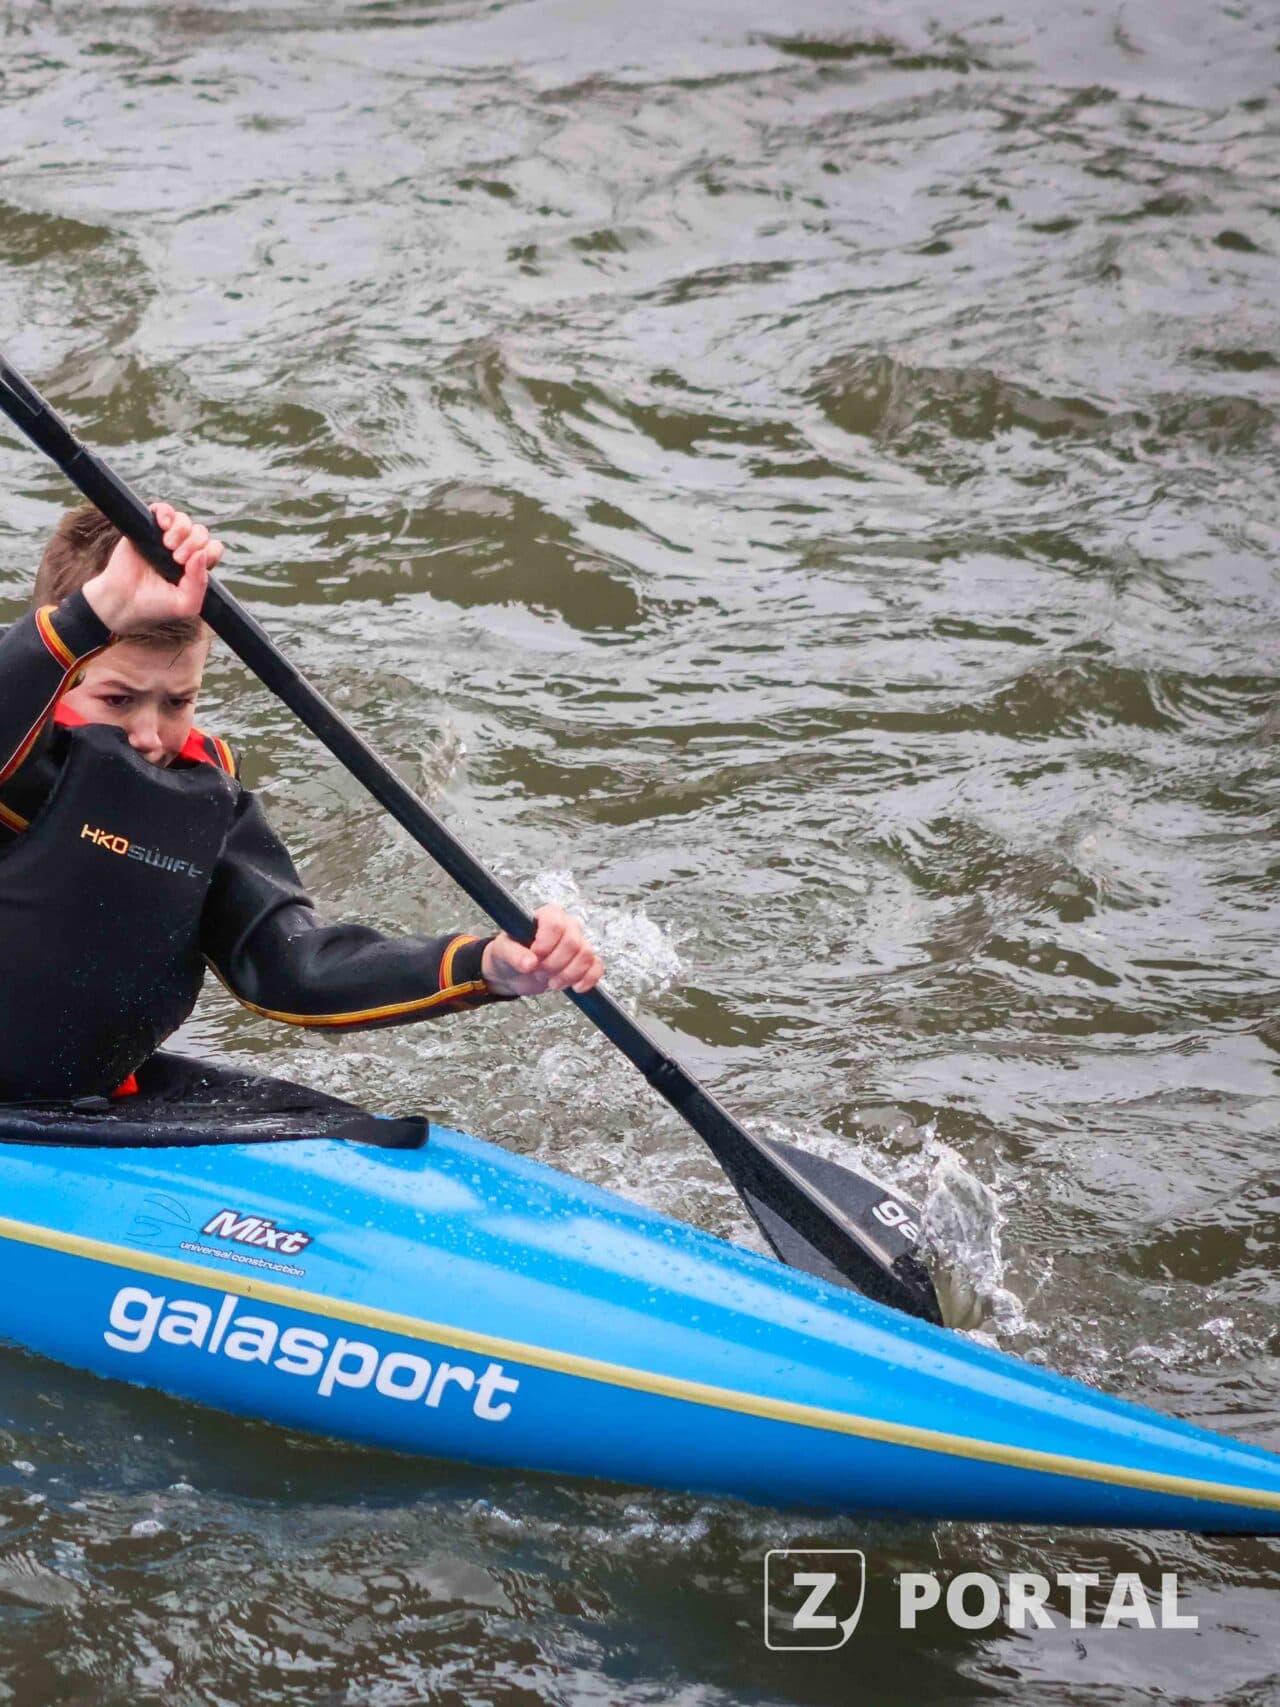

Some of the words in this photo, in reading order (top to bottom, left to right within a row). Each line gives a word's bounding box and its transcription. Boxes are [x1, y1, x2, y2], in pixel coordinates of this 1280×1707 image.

[202, 1209, 313, 1255] Mixt
[180, 1240, 233, 1260] universal
[231, 1254, 305, 1278] construction
[103, 1286, 520, 1422] galasport
